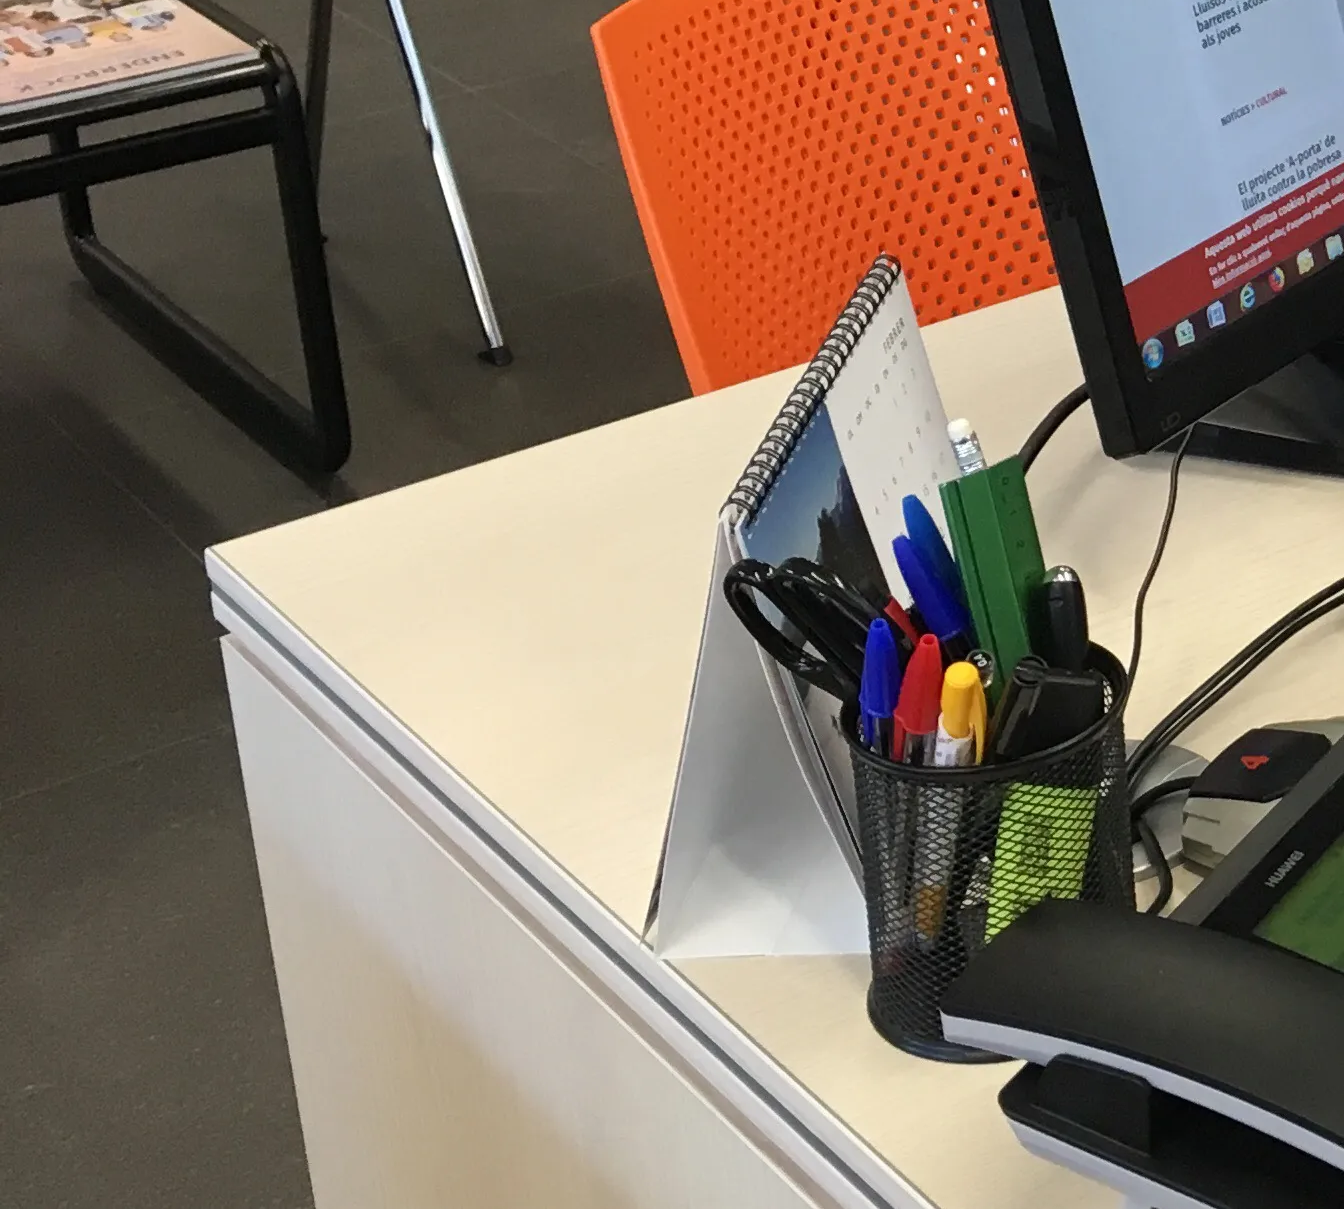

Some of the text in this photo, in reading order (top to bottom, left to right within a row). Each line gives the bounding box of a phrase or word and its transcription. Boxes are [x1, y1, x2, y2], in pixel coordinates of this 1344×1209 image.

[1195, 2, 1237, 34] barreres
[1200, 19, 1242, 50] als joves
[1236, 179, 1248, 196] El
[1247, 159, 1286, 193] projecte
[1323, 130, 1336, 148] de
[1240, 144, 1343, 213] lluita contra la pobresa
[882, 316, 907, 355] FEBRER
[1263, 849, 1306, 889] HUAWEI
